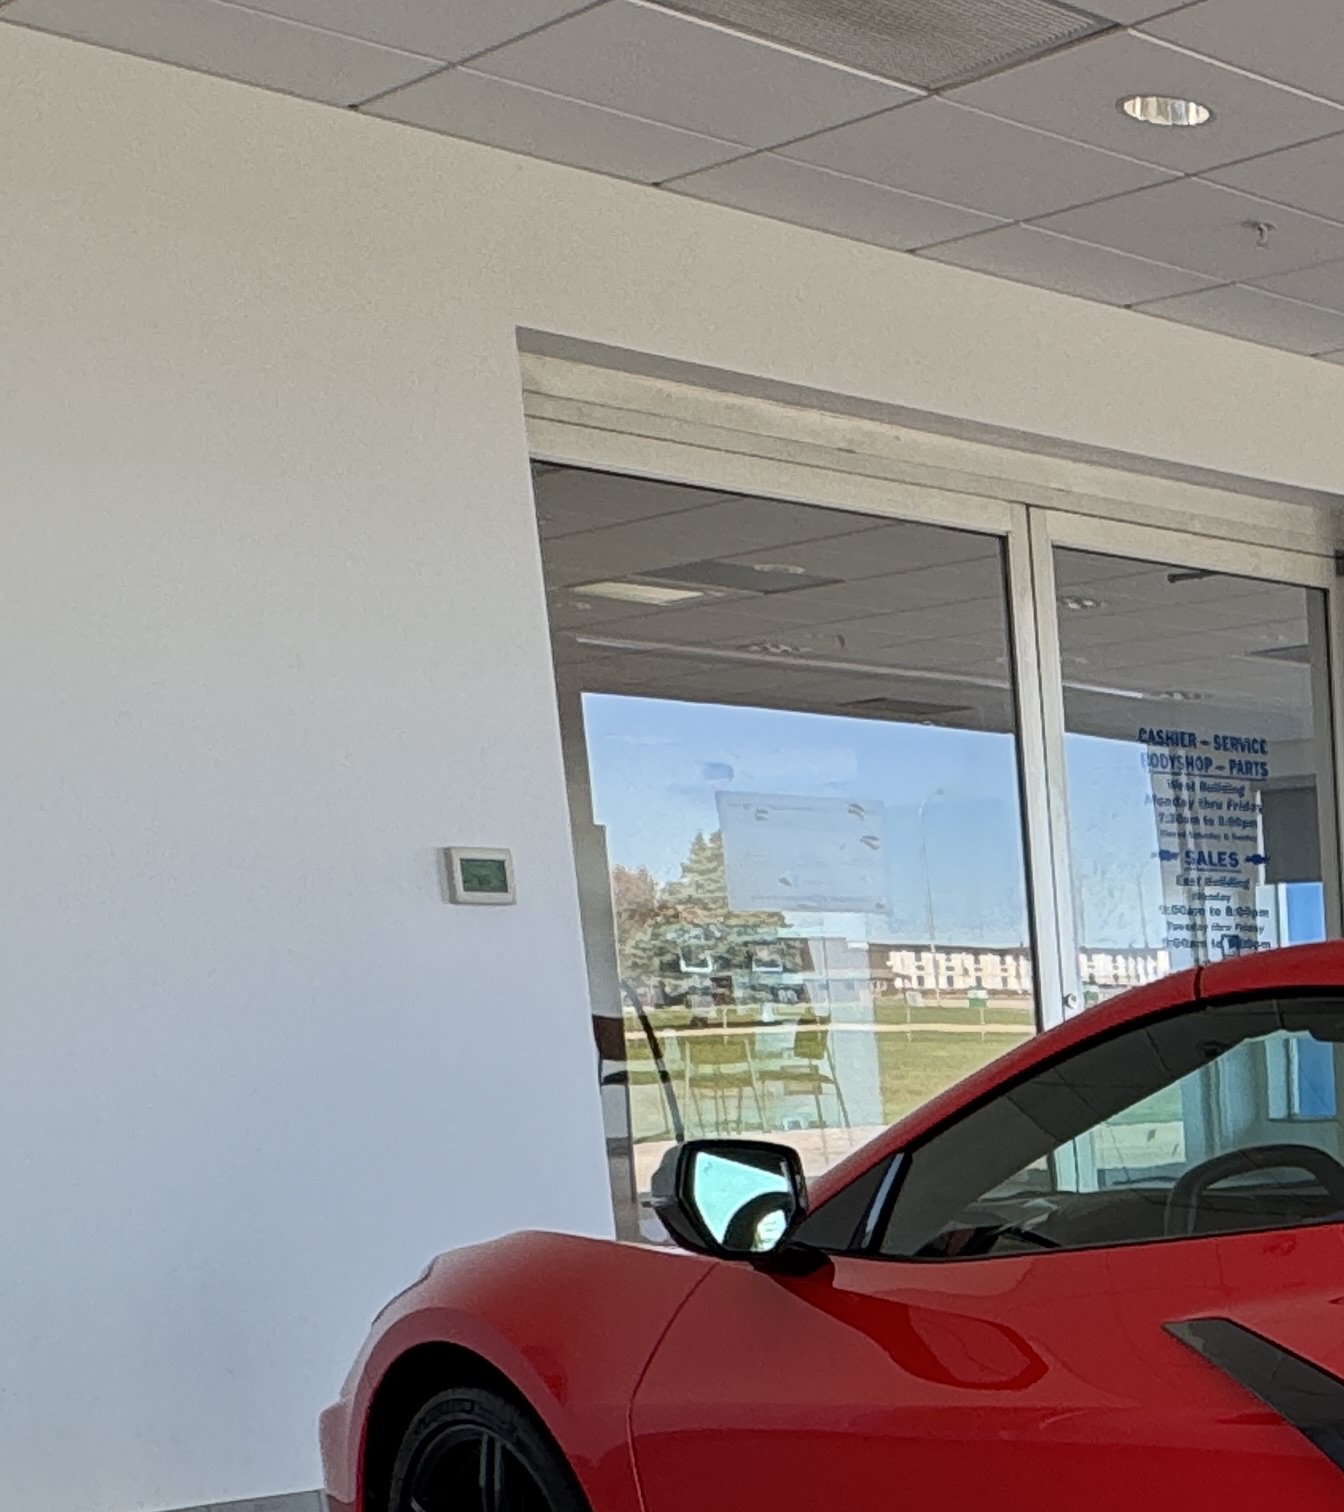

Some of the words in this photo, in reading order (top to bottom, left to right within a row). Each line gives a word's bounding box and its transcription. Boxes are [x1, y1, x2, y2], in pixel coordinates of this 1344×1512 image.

[1138, 728, 1197, 749] CASHIER
[1213, 735, 1268, 754] SERVICE
[1228, 759, 1269, 777] PARTS
[1184, 849, 1240, 868] SALES
